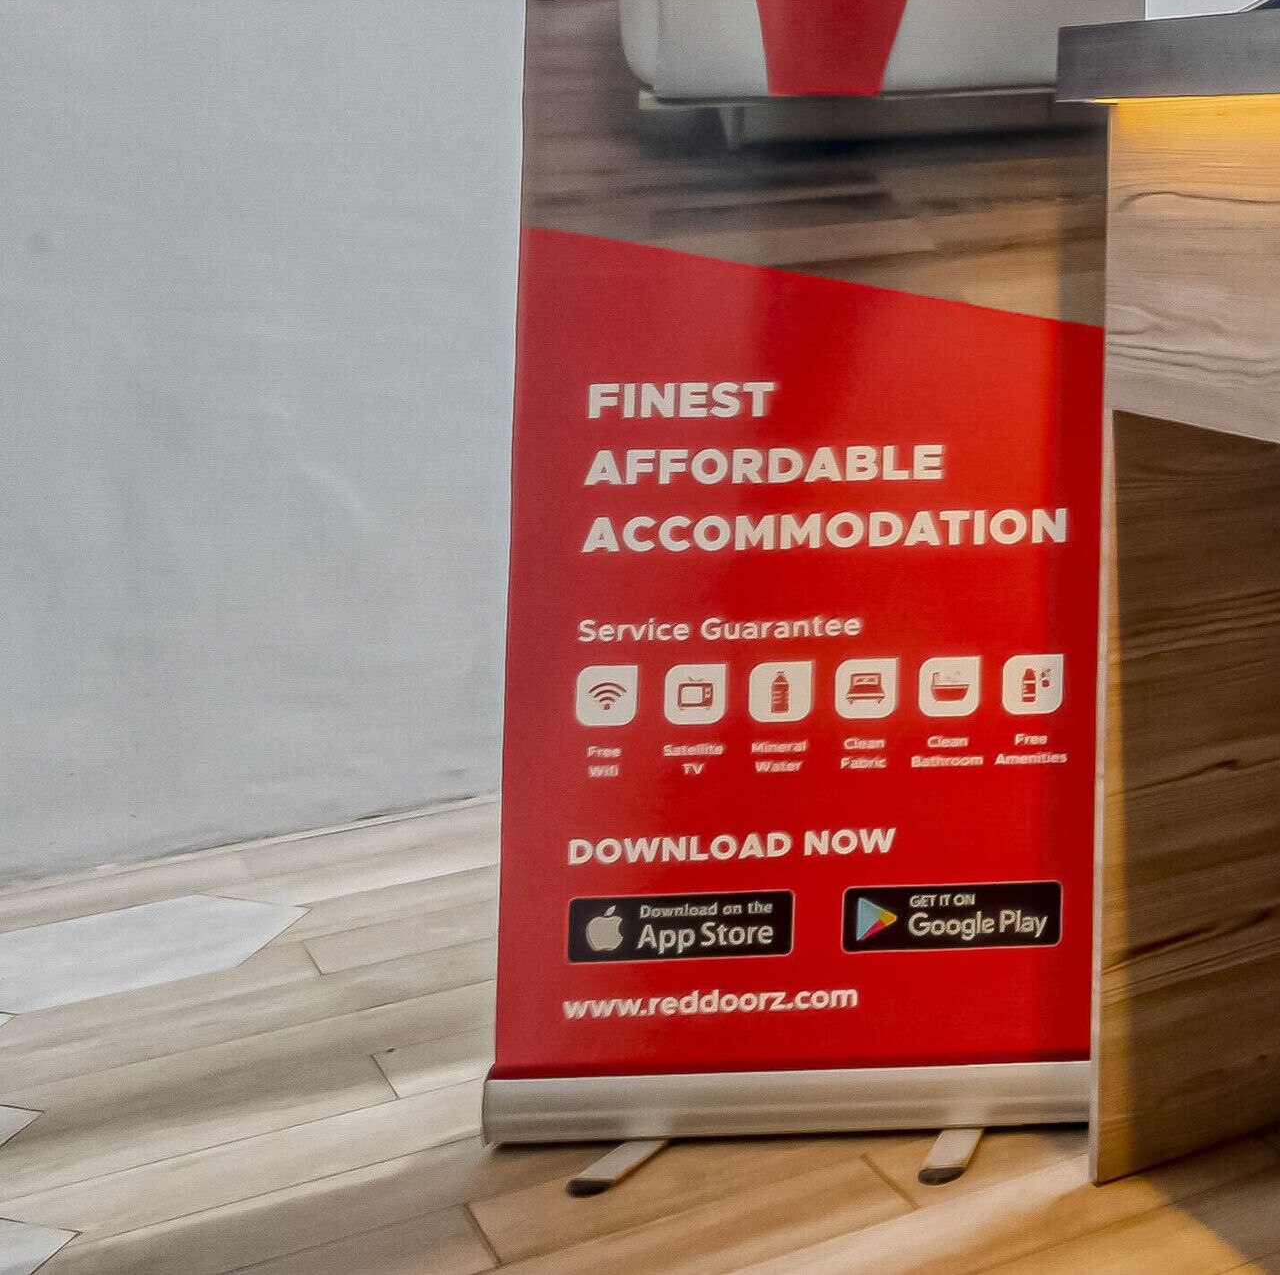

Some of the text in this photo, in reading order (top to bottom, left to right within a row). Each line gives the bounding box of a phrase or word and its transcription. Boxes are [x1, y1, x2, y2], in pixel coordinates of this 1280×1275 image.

[588, 381, 775, 418] FINEST
[584, 444, 945, 485] AFFORDABLE
[581, 507, 1068, 553] ACCOMMODATION
[577, 615, 862, 642] Service Guarantee
[844, 737, 885, 749] Clean
[927, 735, 969, 748] Clean
[1014, 734, 1047, 745] Free
[587, 746, 621, 758] Free
[663, 743, 724, 756] Satellite
[751, 740, 808, 753] Mineral
[840, 757, 887, 769] Fabric
[911, 755, 984, 768] Bathroom
[995, 752, 1067, 765] Amenities
[682, 763, 704, 774] TV
[755, 761, 803, 772] Water
[568, 828, 897, 865] DOWNLOAD NOW
[910, 893, 975, 907] GET IT ON
[639, 900, 773, 919] Download on the
[908, 909, 1047, 942] Google Play
[637, 921, 774, 956] App Store
[563, 986, 859, 1019] www.reddoorz.com
